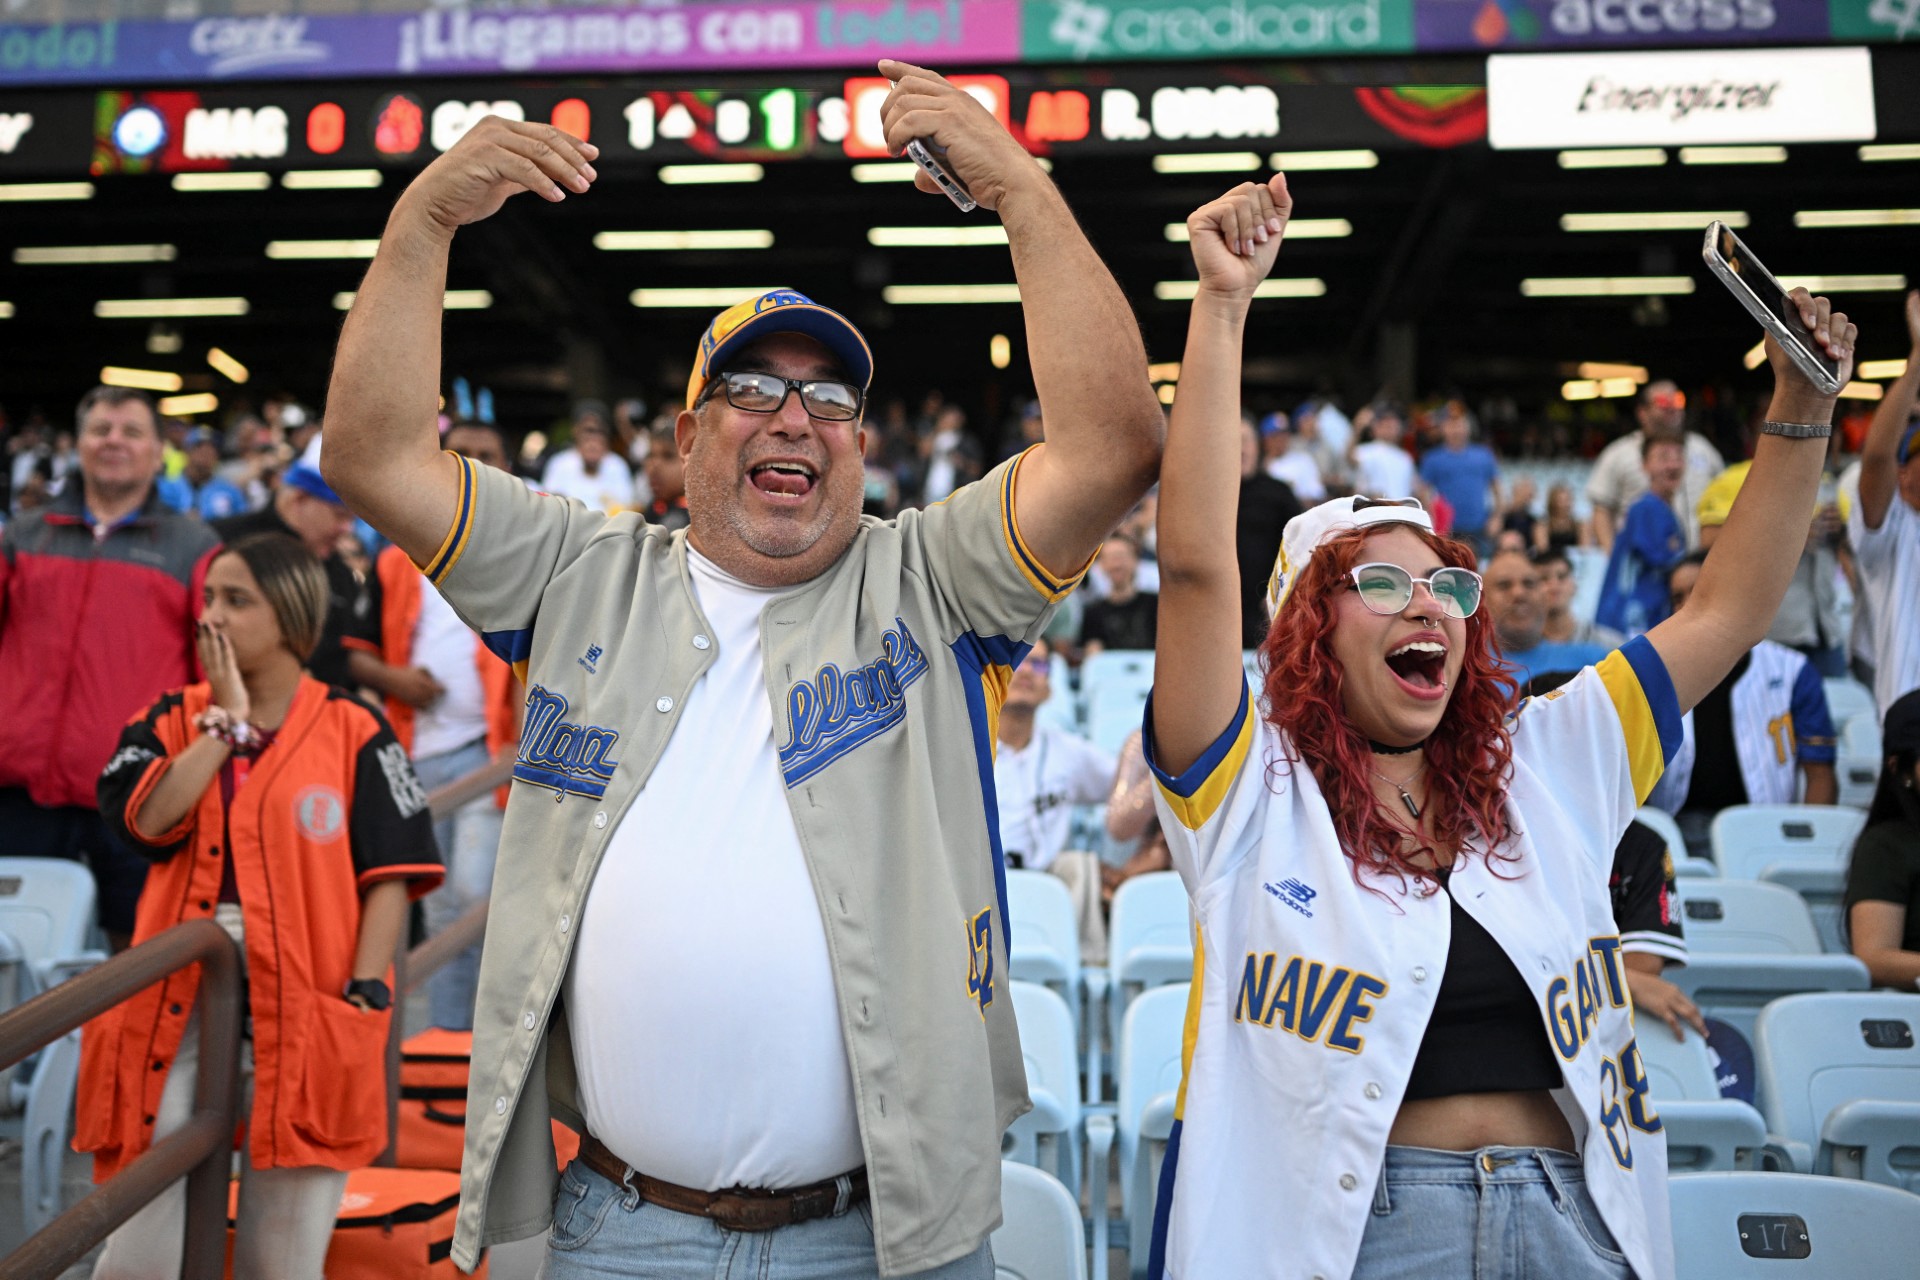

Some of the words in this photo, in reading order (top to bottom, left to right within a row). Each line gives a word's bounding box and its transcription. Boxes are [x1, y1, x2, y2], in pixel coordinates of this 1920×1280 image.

[397, 8, 690, 72] ¡Llegamos
[701, 9, 804, 53] con
[816, 1, 963, 49] todo!
[1111, 0, 1381, 52] credicard
[1550, 0, 1777, 35] access
[1577, 76, 1781, 121] Energizer
[1235, 951, 1389, 1055] NAVE
[1757, 1223, 1788, 1252] 17
